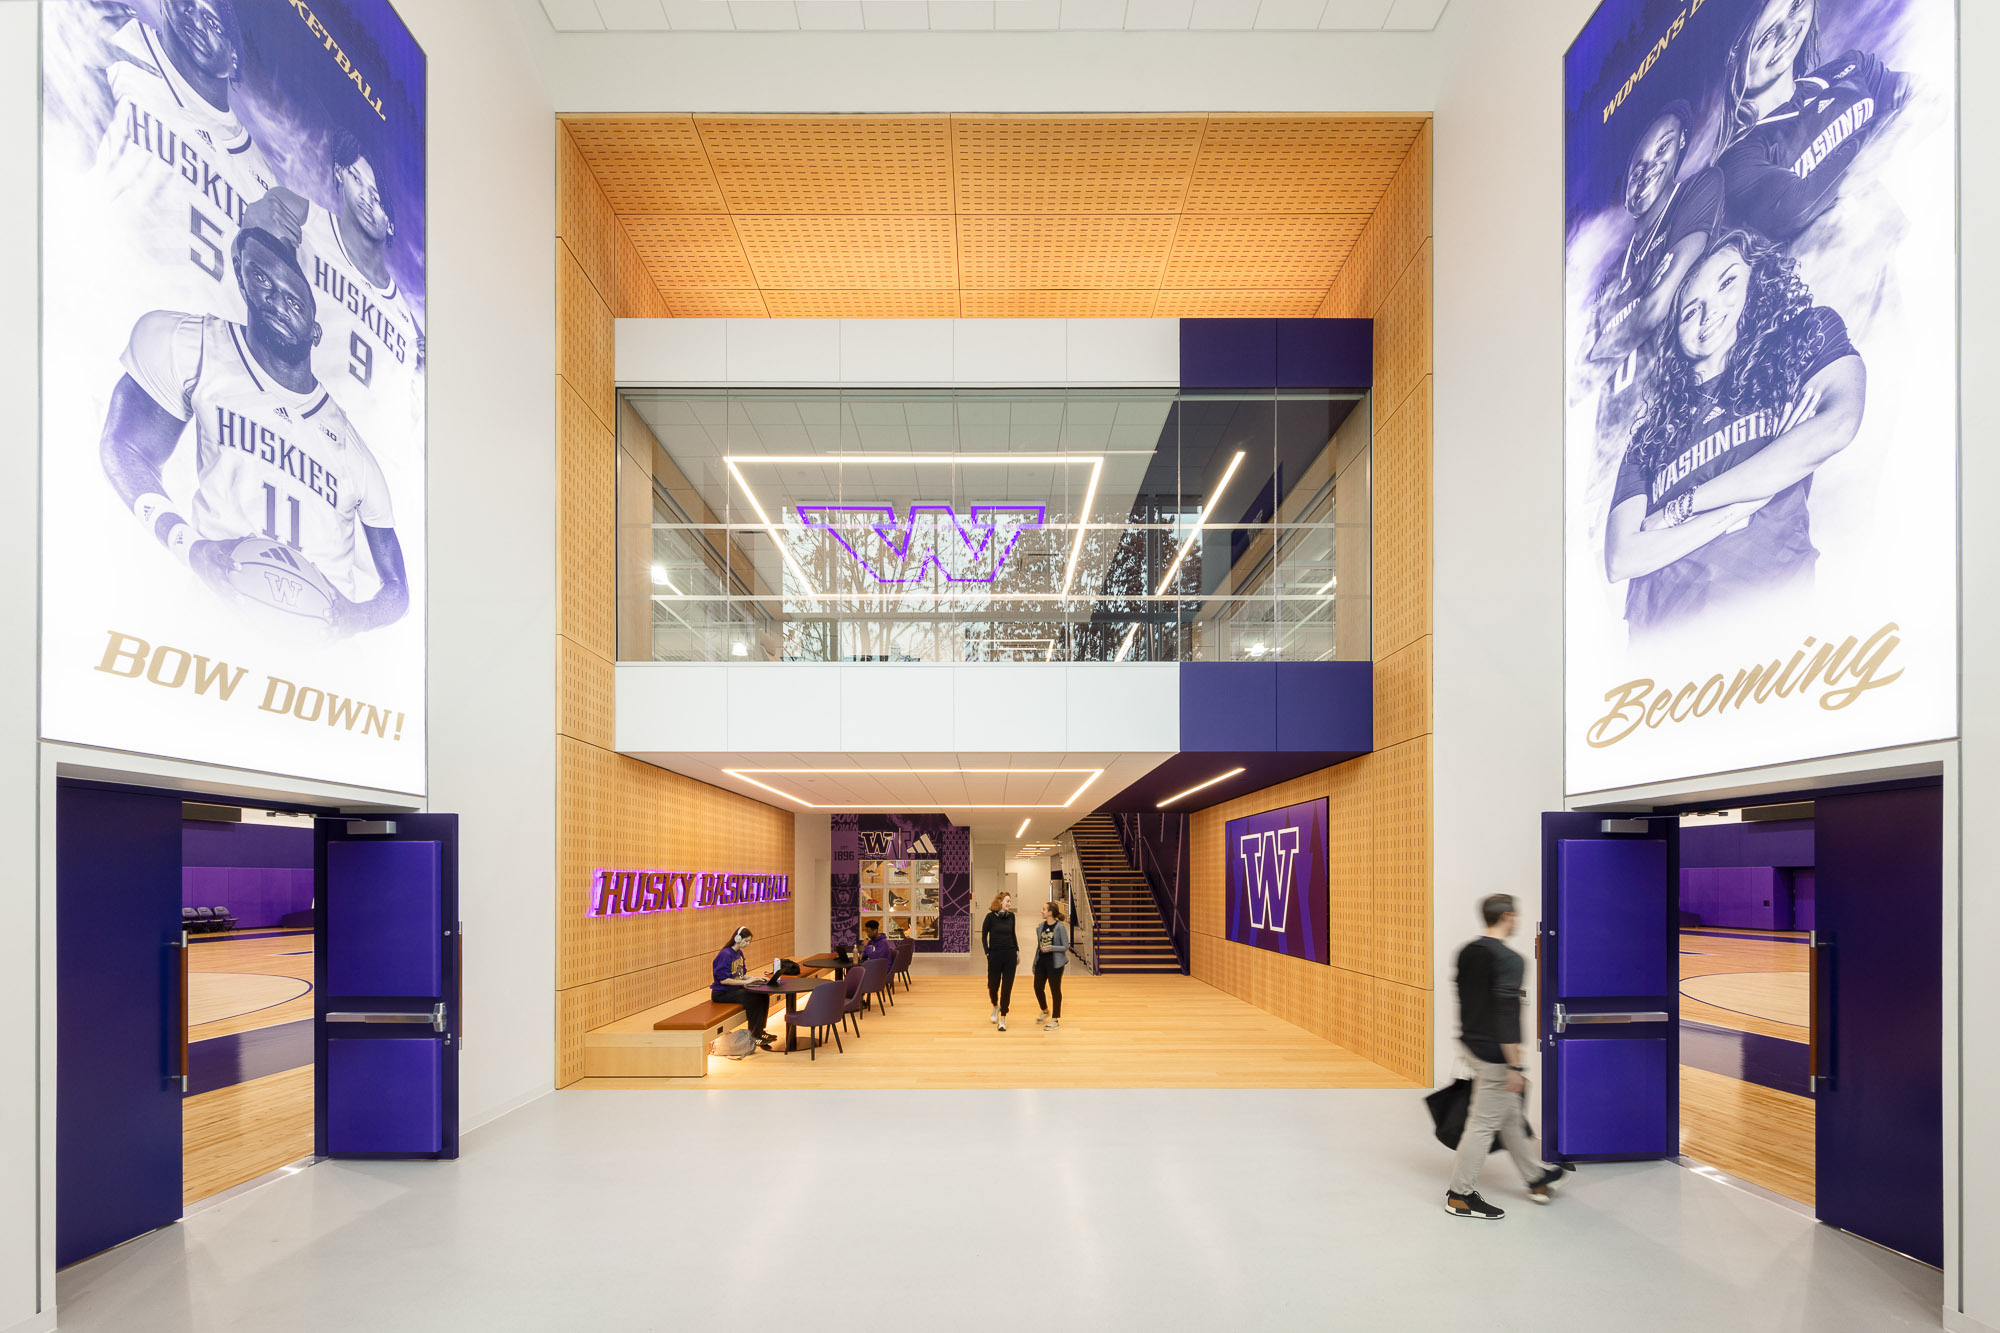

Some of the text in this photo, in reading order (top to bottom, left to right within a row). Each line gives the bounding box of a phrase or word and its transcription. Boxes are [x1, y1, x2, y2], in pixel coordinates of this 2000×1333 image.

[1603, 8, 1687, 124] WOMEN'S
[130, 102, 250, 228] HUSKIE
[190, 204, 224, 283] 5
[314, 254, 406, 364] HUSKIES
[349, 330, 373, 389] 9
[216, 406, 338, 509] HUSKIES
[262, 482, 303, 553] 11
[797, 505, 1046, 583] W
[264, 571, 303, 608] W
[94, 630, 406, 741] BOW DOWN!
[1586, 622, 1905, 749] Becoming
[834, 851, 855, 861] 1896
[861, 831, 894, 855] W
[1241, 826, 1300, 933] W
[595, 871, 698, 915] HUSKY
[698, 873, 791, 906] BASKETBALL
